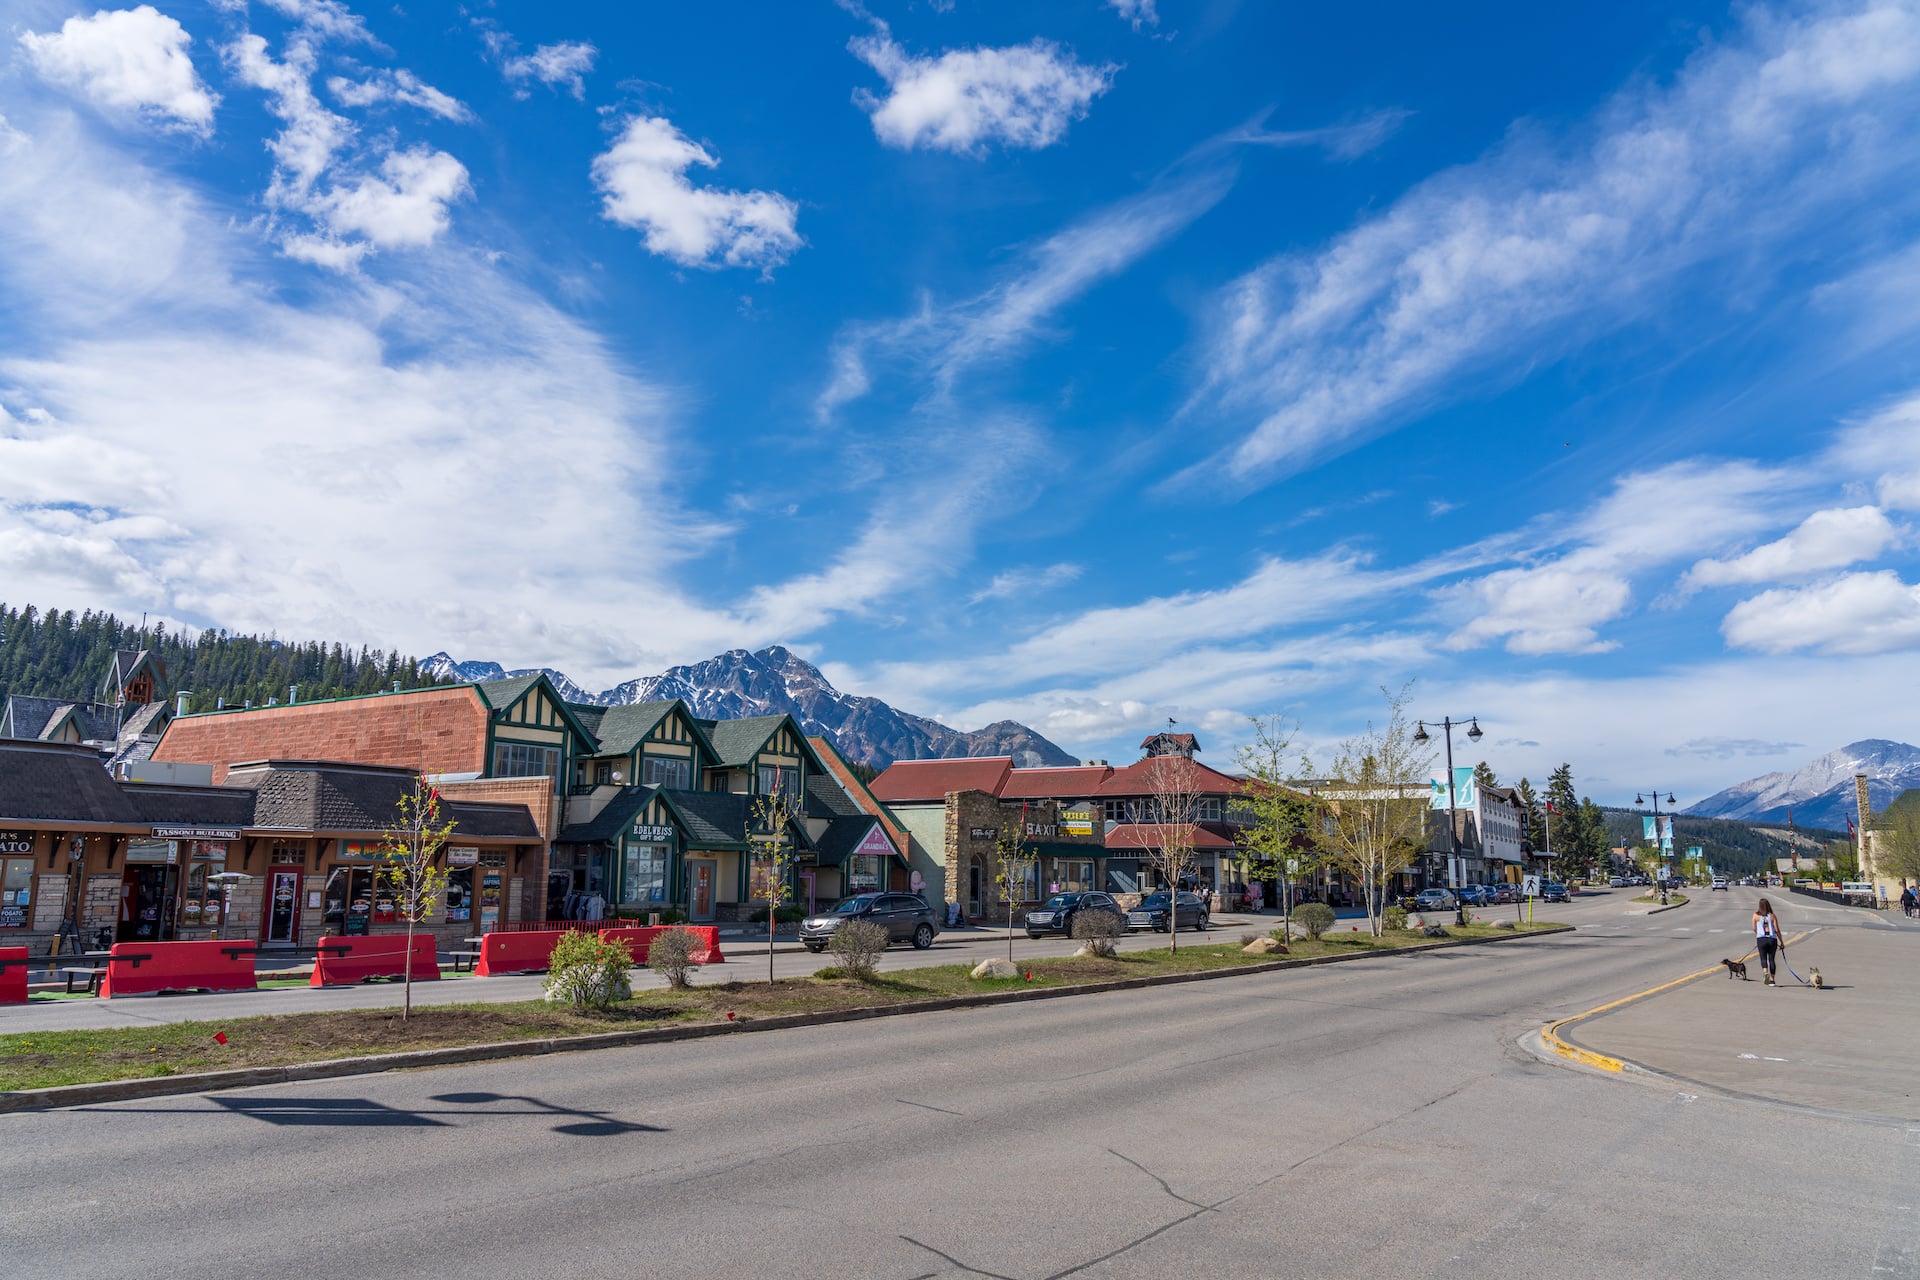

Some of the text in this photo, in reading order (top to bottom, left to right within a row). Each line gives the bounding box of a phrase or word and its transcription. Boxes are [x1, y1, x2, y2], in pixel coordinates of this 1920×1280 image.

[157, 829, 237, 838] TASSONI BUILDING
[633, 826, 672, 836] EDELWEISS
[0, 841, 30, 852] ATO
